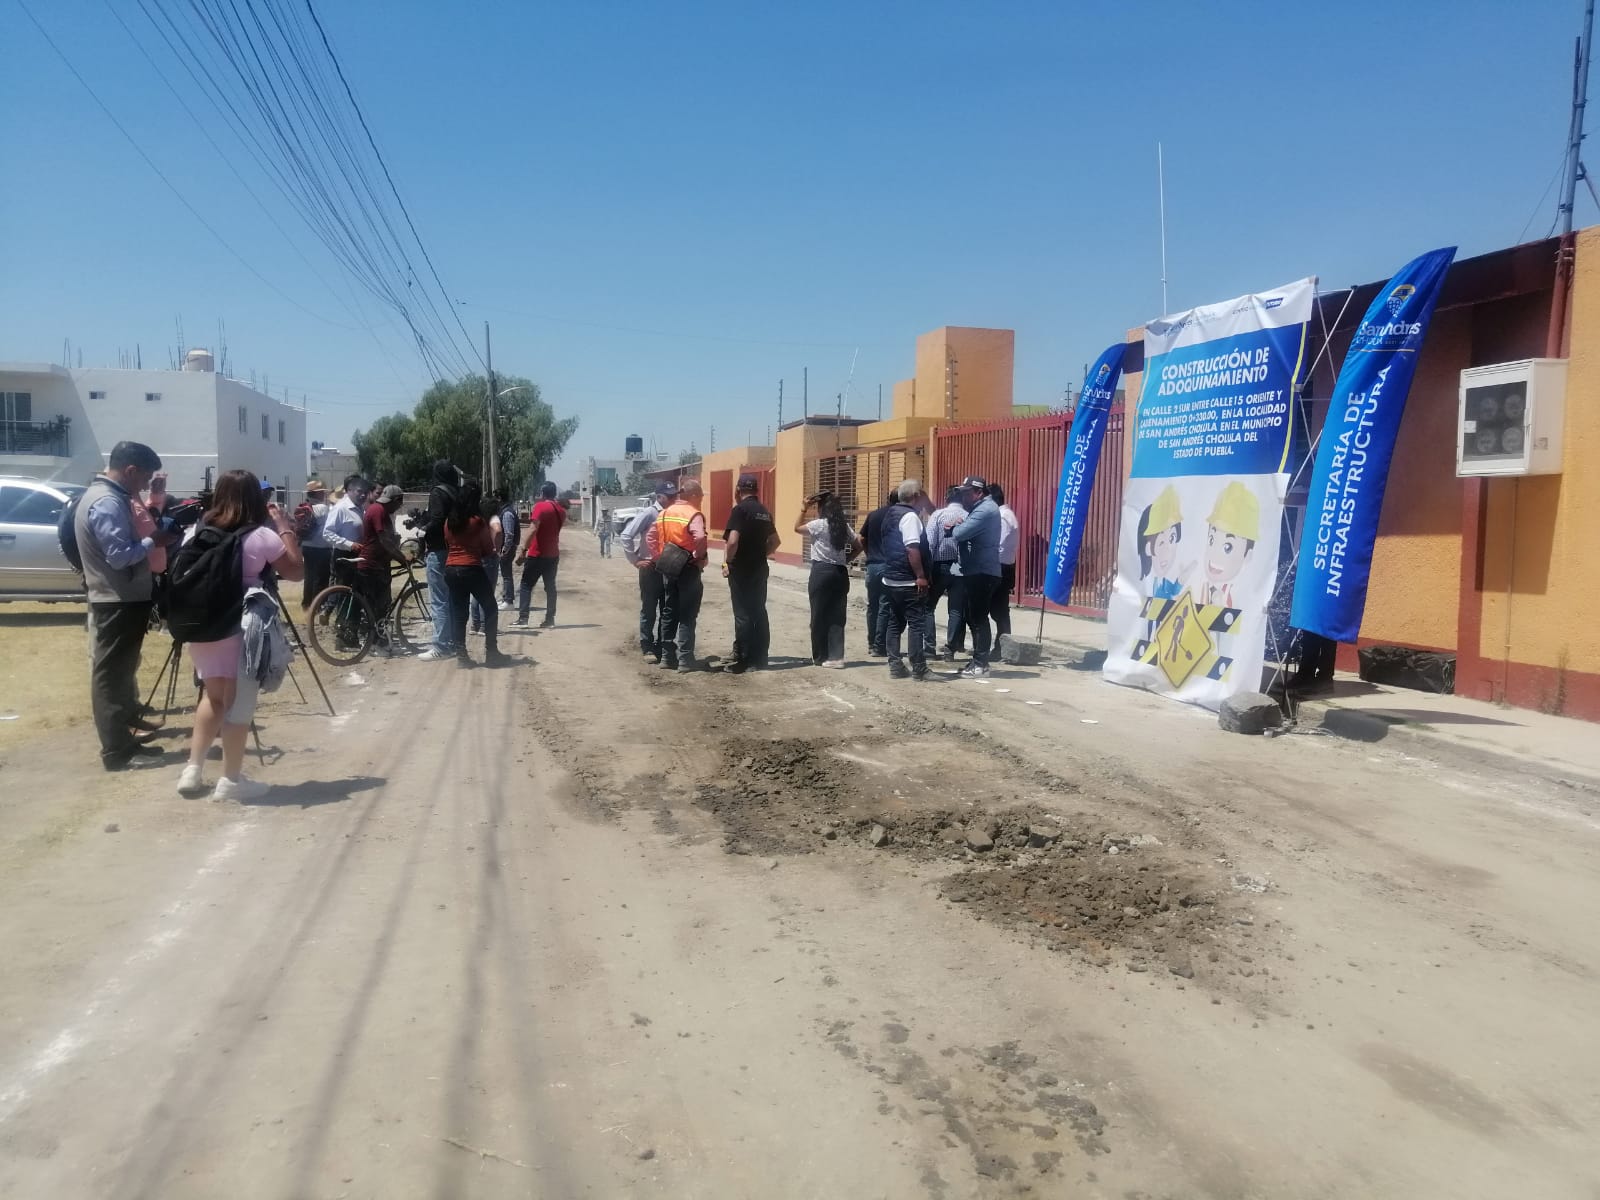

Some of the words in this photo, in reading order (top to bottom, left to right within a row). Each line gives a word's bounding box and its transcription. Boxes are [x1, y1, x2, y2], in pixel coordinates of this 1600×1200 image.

[1162, 348, 1252, 380] CONSTRUCCIÓN
[1255, 347, 1270, 364] DE
[1157, 364, 1268, 396] ADOQUINAMIENTO
[1142, 408, 1151, 417] EN
[1151, 405, 1172, 416] CALLE
[1173, 404, 1178, 414] 2
[1179, 403, 1191, 413] SUR
[1191, 399, 1210, 411] ENTRE
[1210, 397, 1233, 408] CALLE
[1234, 395, 1244, 405] 15
[1245, 390, 1275, 405] ORIENTE
[1277, 390, 1283, 401] Y
[1221, 408, 1233, 420] EN
[1233, 407, 1243, 418] LA
[1145, 428, 1161, 439] SAN
[1163, 424, 1188, 438] ANDRÉS
[1188, 422, 1218, 435] CHOLULA
[1220, 421, 1231, 432] EN
[1231, 420, 1240, 430] EL
[1158, 439, 1168, 449] DE
[1169, 438, 1180, 448] SAN
[1181, 433, 1204, 447] ANDRÉS
[1205, 432, 1241, 444] CHOLULA
[1243, 431, 1258, 442] DEL
[1074, 434, 1086, 455] DE
[1173, 448, 1194, 459] ESTADO
[1194, 447, 1202, 457] DE
[1313, 431, 1353, 570] SECRETARÍA
[1344, 391, 1366, 423] DE
[1327, 365, 1392, 597] INFRAESTRUCTURA
